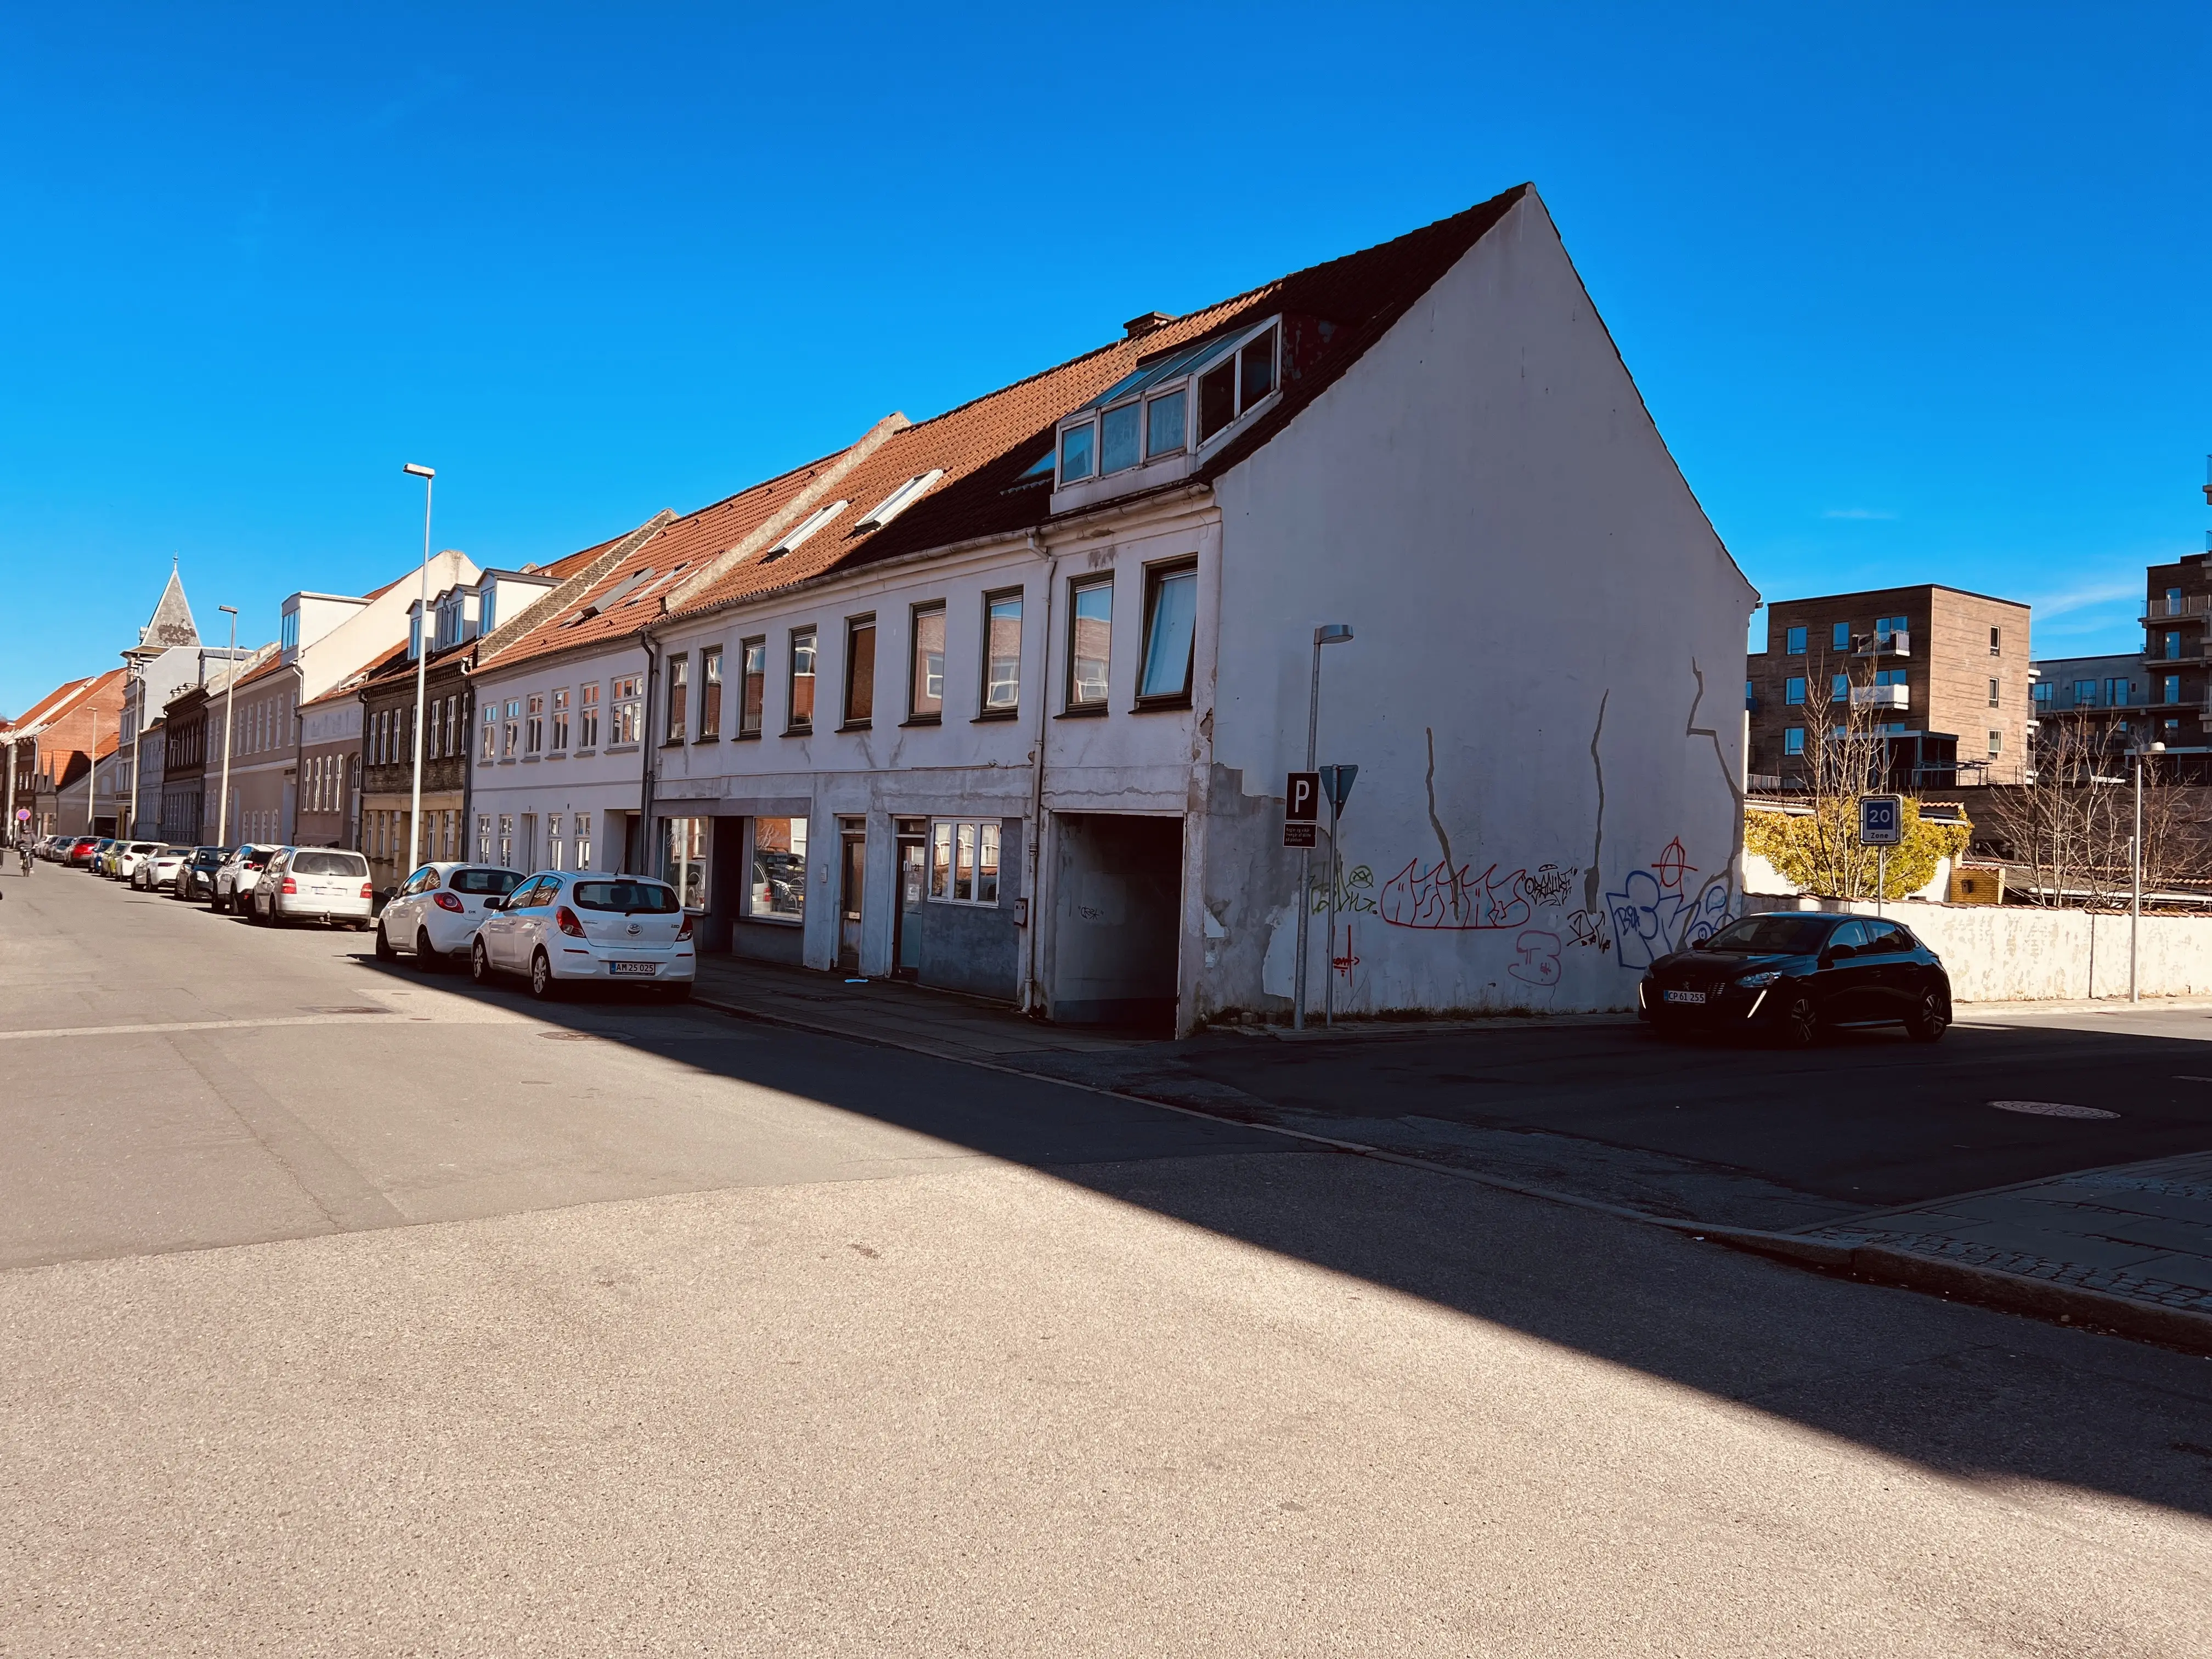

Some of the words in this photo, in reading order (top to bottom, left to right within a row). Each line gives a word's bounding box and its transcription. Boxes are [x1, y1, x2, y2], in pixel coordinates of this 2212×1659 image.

[1295, 780, 1310, 813] P
[1869, 809, 1891, 823] 20
[616, 963, 627, 972] AM
[640, 964, 653, 972] 025
[1668, 992, 1678, 1000] CP
[1679, 992, 1688, 1001] 61
[1690, 993, 1704, 1002] 255
